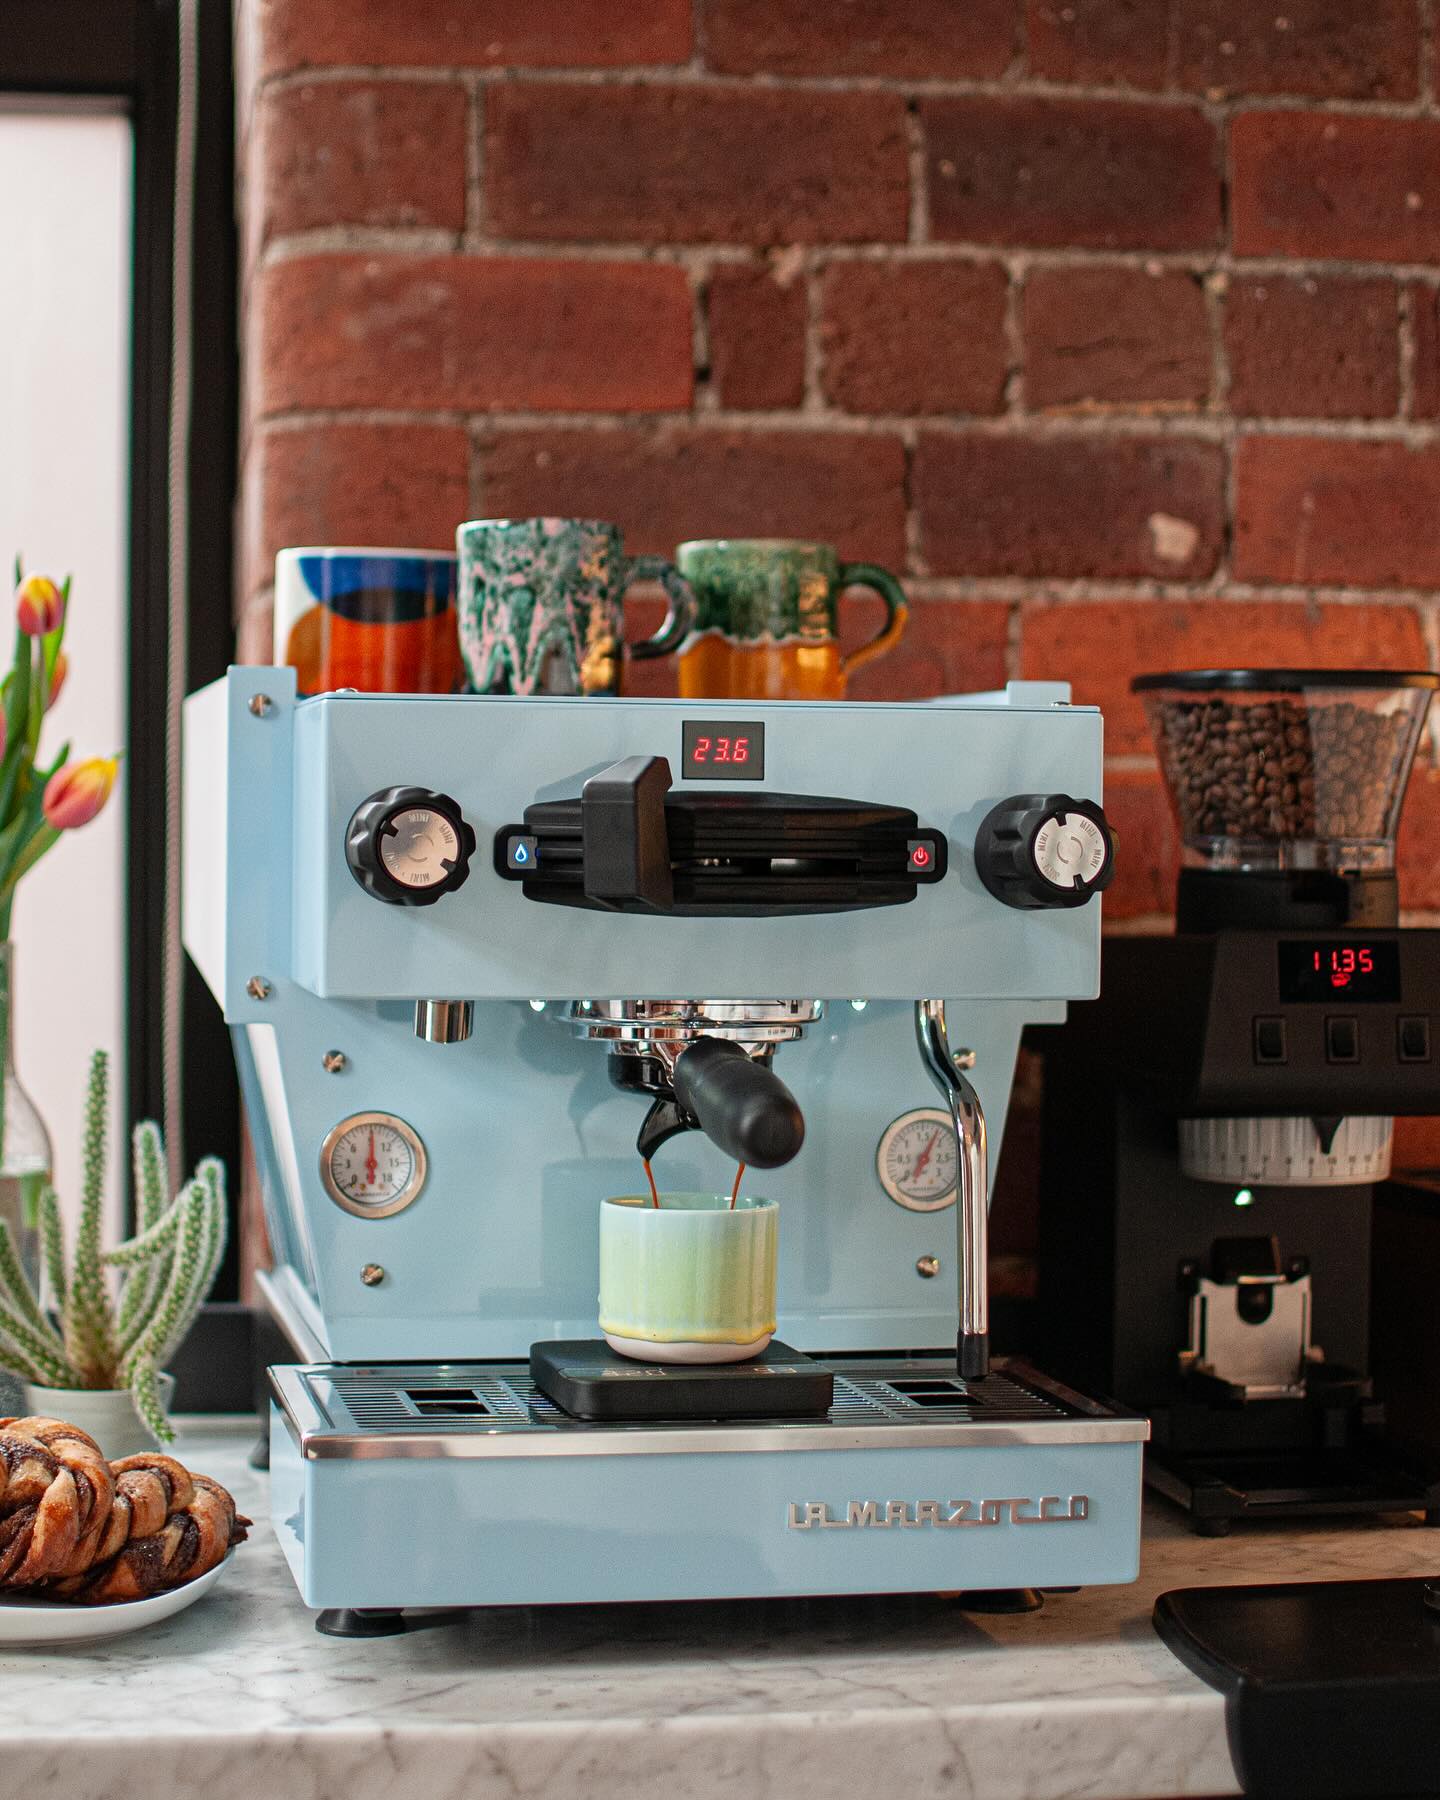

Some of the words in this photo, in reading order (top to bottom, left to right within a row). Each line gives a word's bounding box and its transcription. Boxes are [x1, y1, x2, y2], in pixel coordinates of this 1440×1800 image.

[693, 738, 748, 762] 23.6
[408, 814, 430, 823] MINI
[440, 824, 454, 844] MINI
[1313, 949, 1374, 973] 11.35
[382, 1143, 392, 1153] 12
[389, 1158, 400, 1168] 15
[382, 1173, 393, 1183] 18
[788, 1501, 827, 1529] LA
[849, 1496, 1089, 1529] MARZOCCO
